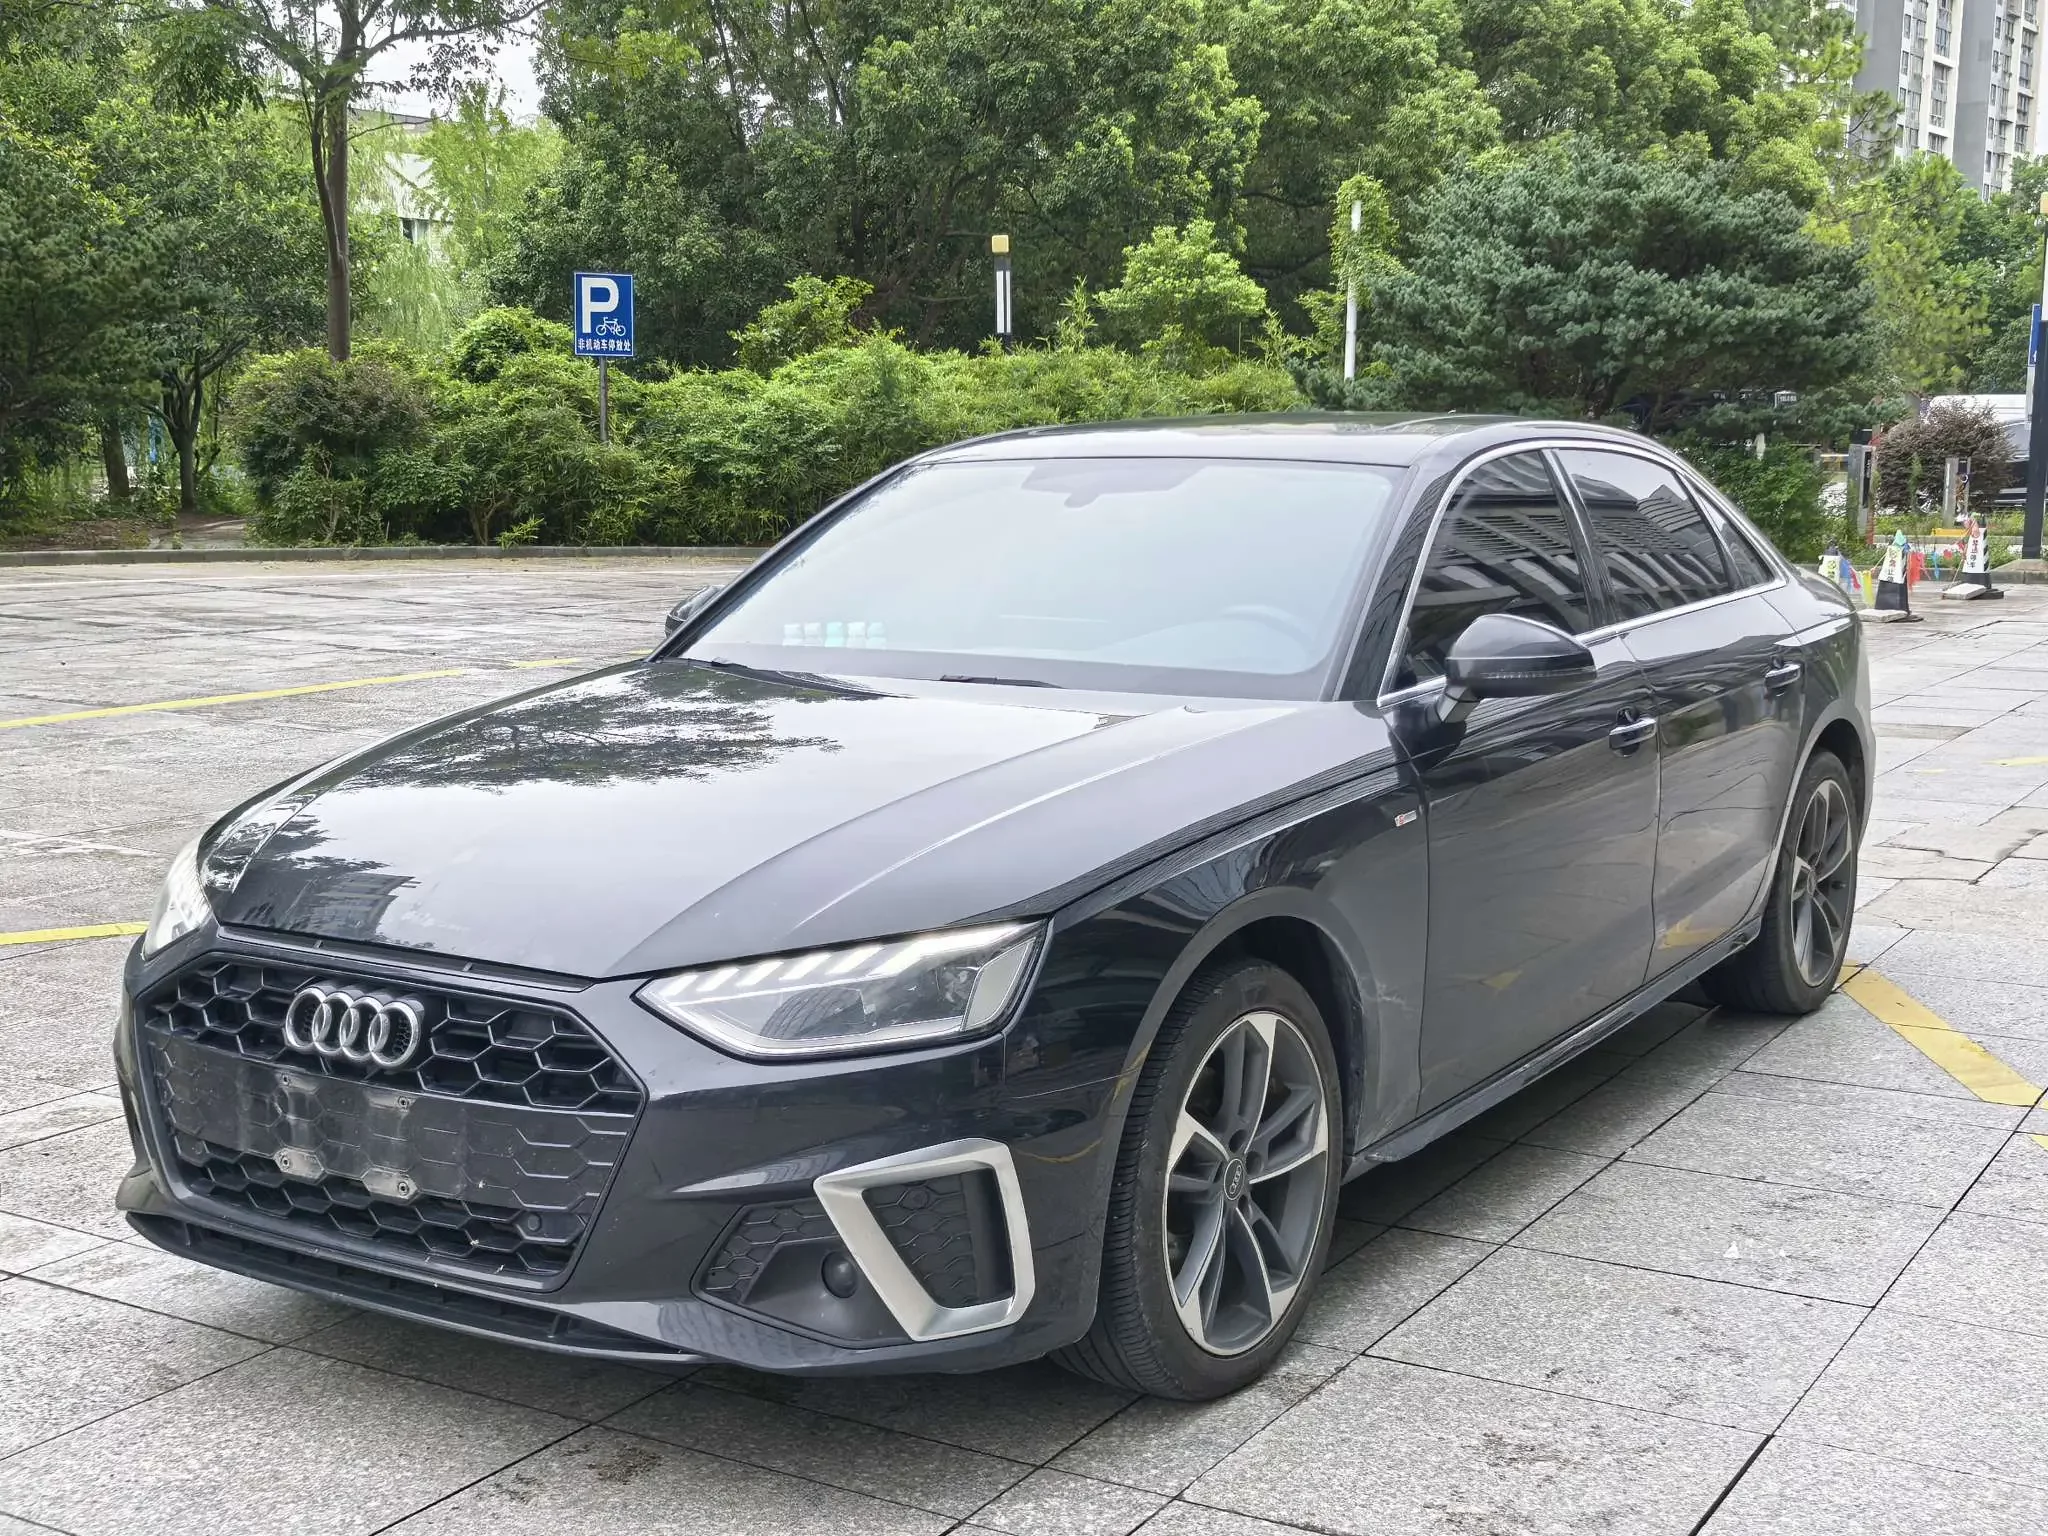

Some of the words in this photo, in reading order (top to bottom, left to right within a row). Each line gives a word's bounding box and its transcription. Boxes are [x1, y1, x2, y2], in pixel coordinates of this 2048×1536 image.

[582, 277, 619, 333] P
[578, 338, 631, 351] 非机动车停放处
